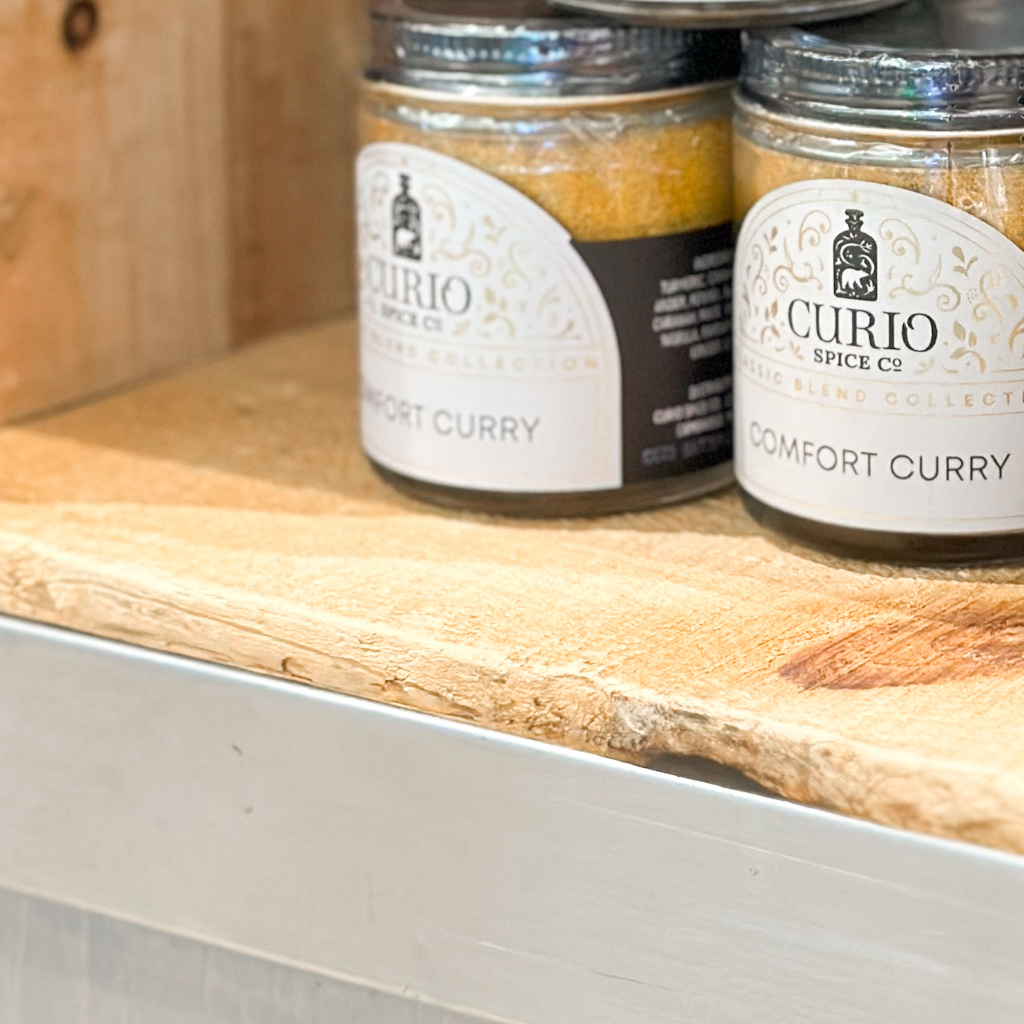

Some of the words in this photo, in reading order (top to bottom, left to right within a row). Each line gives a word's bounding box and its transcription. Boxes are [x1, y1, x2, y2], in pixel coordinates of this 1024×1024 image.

[367, 254, 472, 315] CURIO
[787, 298, 938, 353] CURIO
[428, 349, 598, 372] COLLECTION
[813, 348, 870, 371] SPICE
[795, 378, 867, 403] BLEND
[432, 409, 541, 443] CURRY
[749, 421, 878, 477] COMFORT
[889, 453, 1011, 483] CURRY
